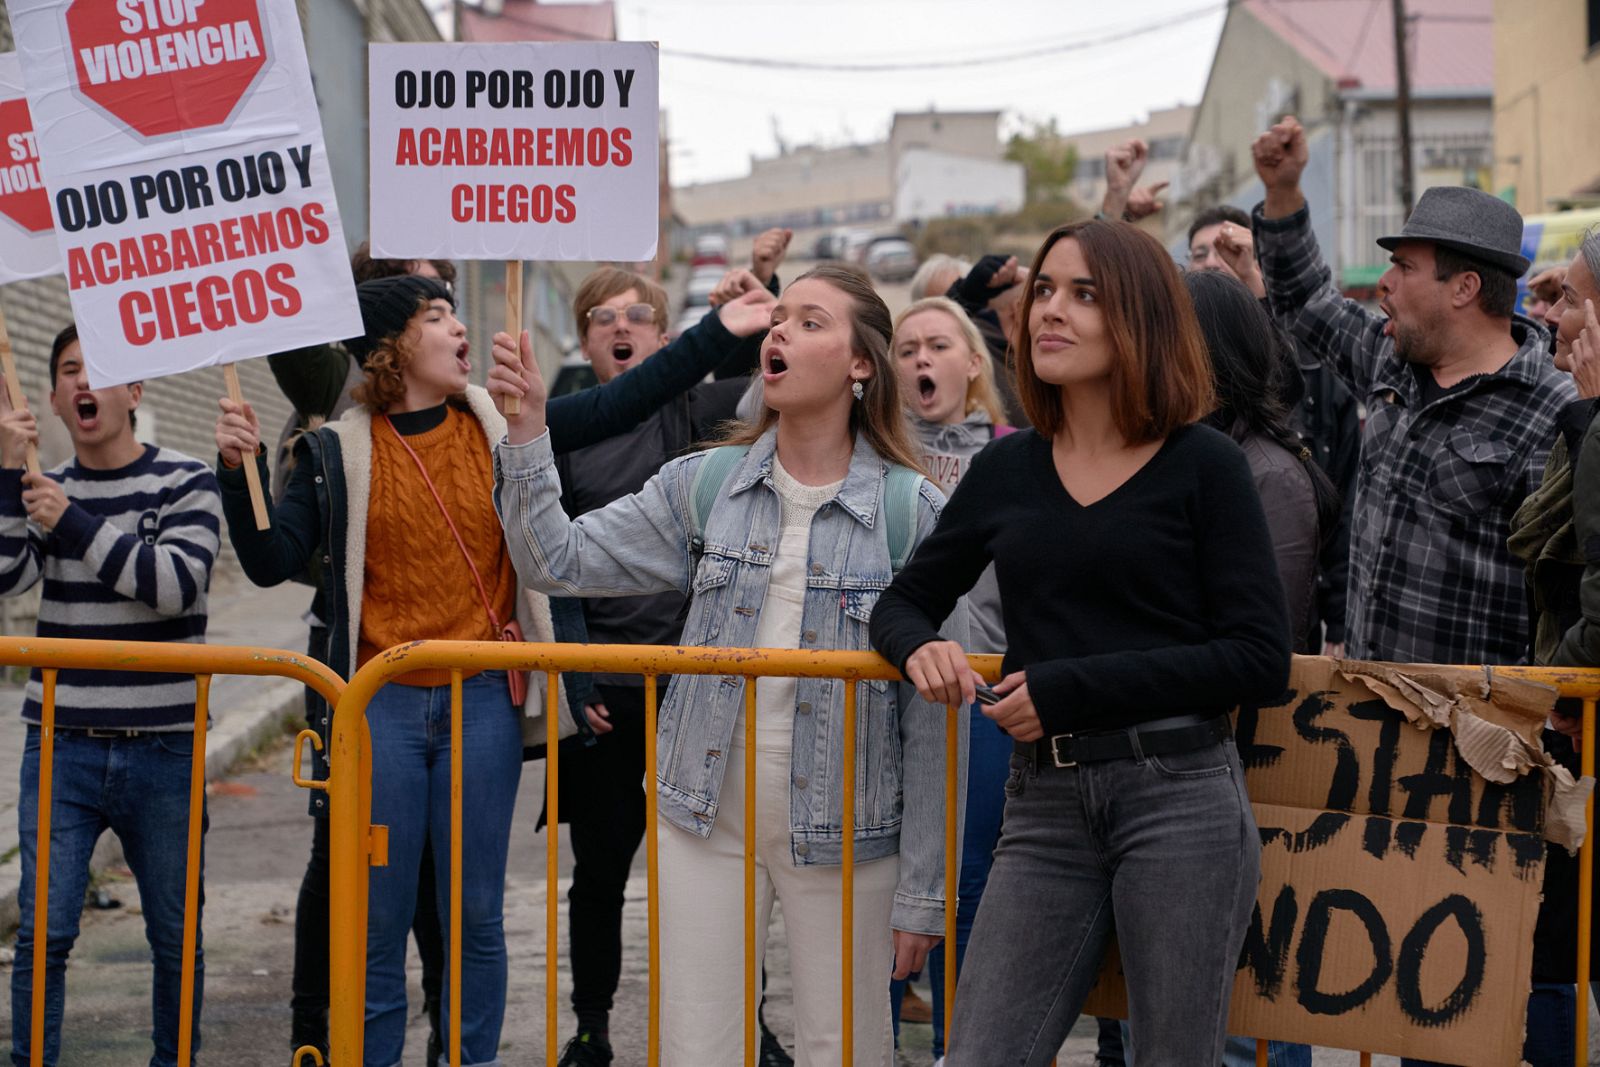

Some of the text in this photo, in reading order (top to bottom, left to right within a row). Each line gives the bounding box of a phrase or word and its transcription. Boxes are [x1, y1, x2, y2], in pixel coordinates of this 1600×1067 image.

[116, 0, 206, 34] STOP
[79, 20, 260, 85] VIOLENCIA
[395, 69, 635, 109] OJO POR OJO Y
[395, 127, 633, 167] ACABAREMOS
[55, 144, 313, 232] OJO POR OJO Y
[451, 183, 577, 224] CIEGOS
[67, 202, 330, 291] ACABAREMOS
[118, 262, 303, 347] CIEGOS
